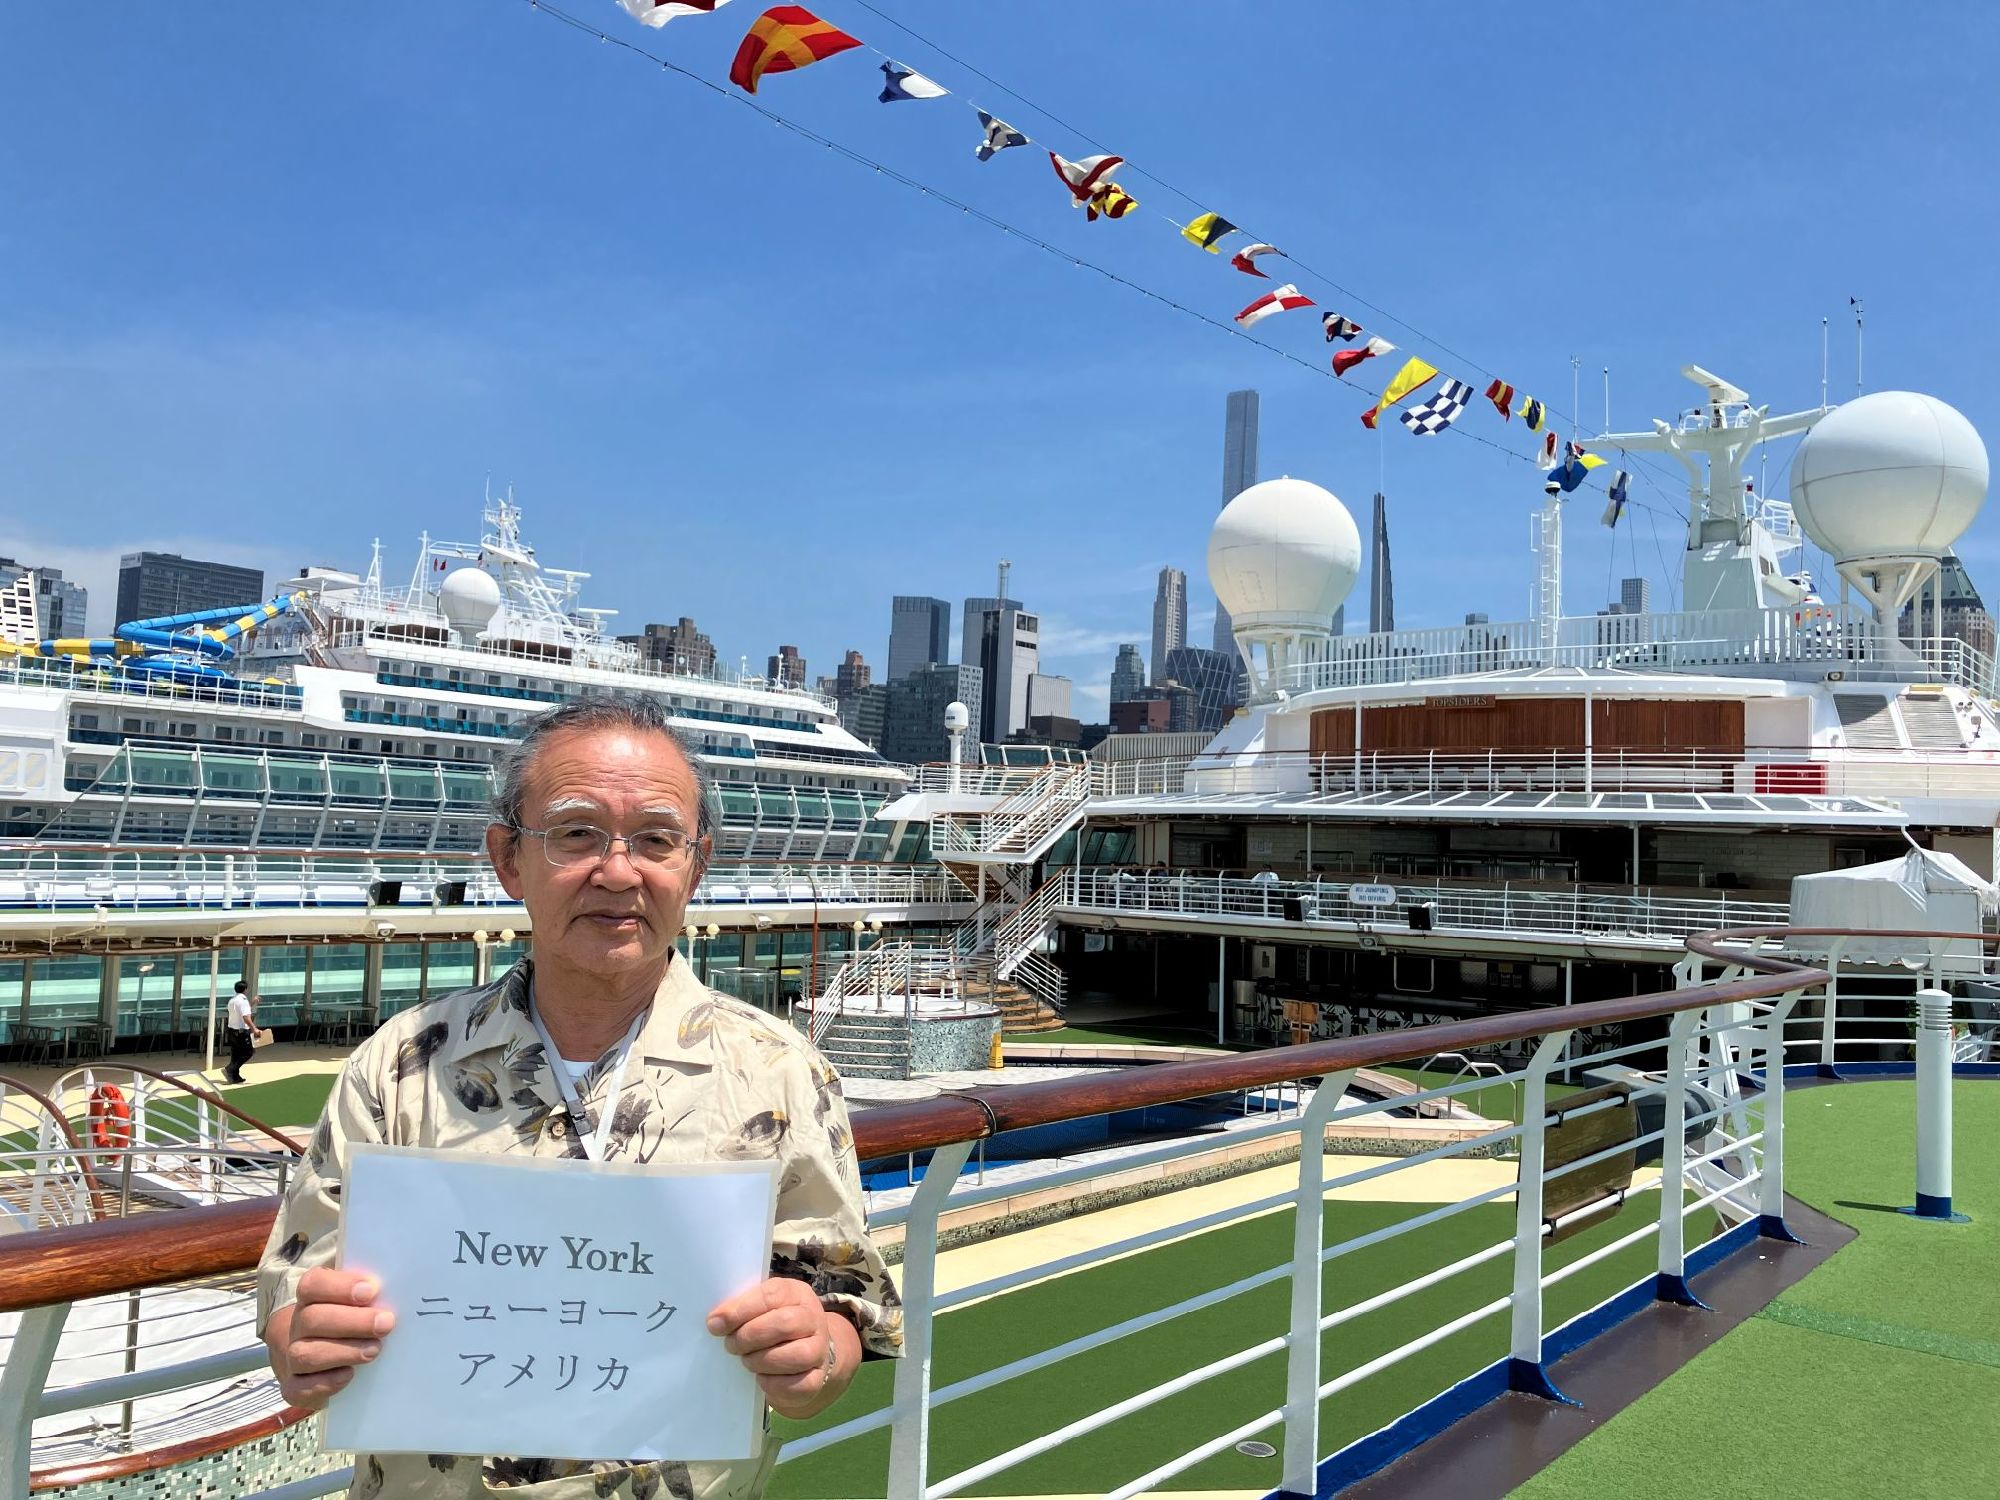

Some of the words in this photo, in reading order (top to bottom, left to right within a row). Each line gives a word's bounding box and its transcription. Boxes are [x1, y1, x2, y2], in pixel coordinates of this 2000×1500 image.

[1432, 696, 1487, 707] TOPSIDERS
[452, 1230, 549, 1268] New
[560, 1236, 654, 1275] York
[416, 1296, 678, 1333] ニューヨーク
[458, 1353, 630, 1392] アメリカ
